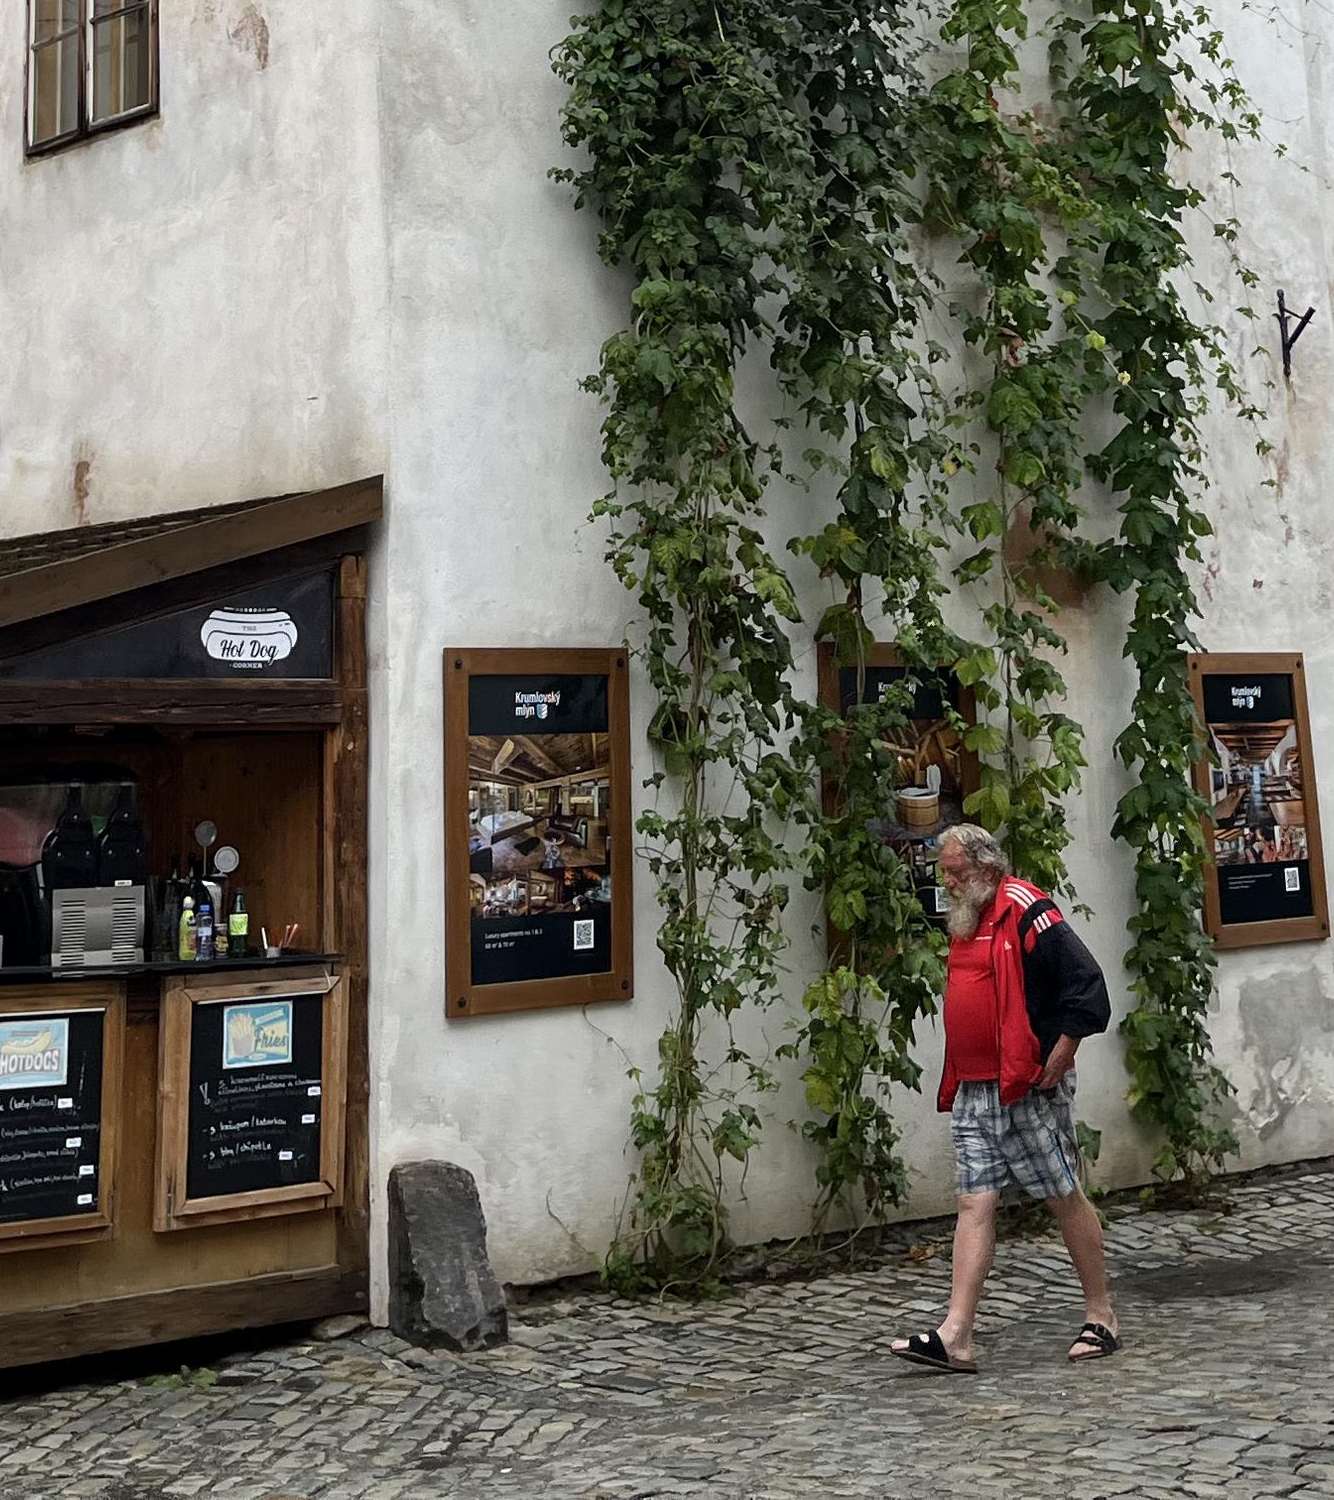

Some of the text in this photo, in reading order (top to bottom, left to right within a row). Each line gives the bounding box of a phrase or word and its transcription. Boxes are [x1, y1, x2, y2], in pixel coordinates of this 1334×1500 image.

[220, 639, 280, 666] Hot Dog
[515, 691, 561, 706] Krumlovský
[515, 704, 535, 718] mlýn
[254, 1025, 287, 1052] Fries
